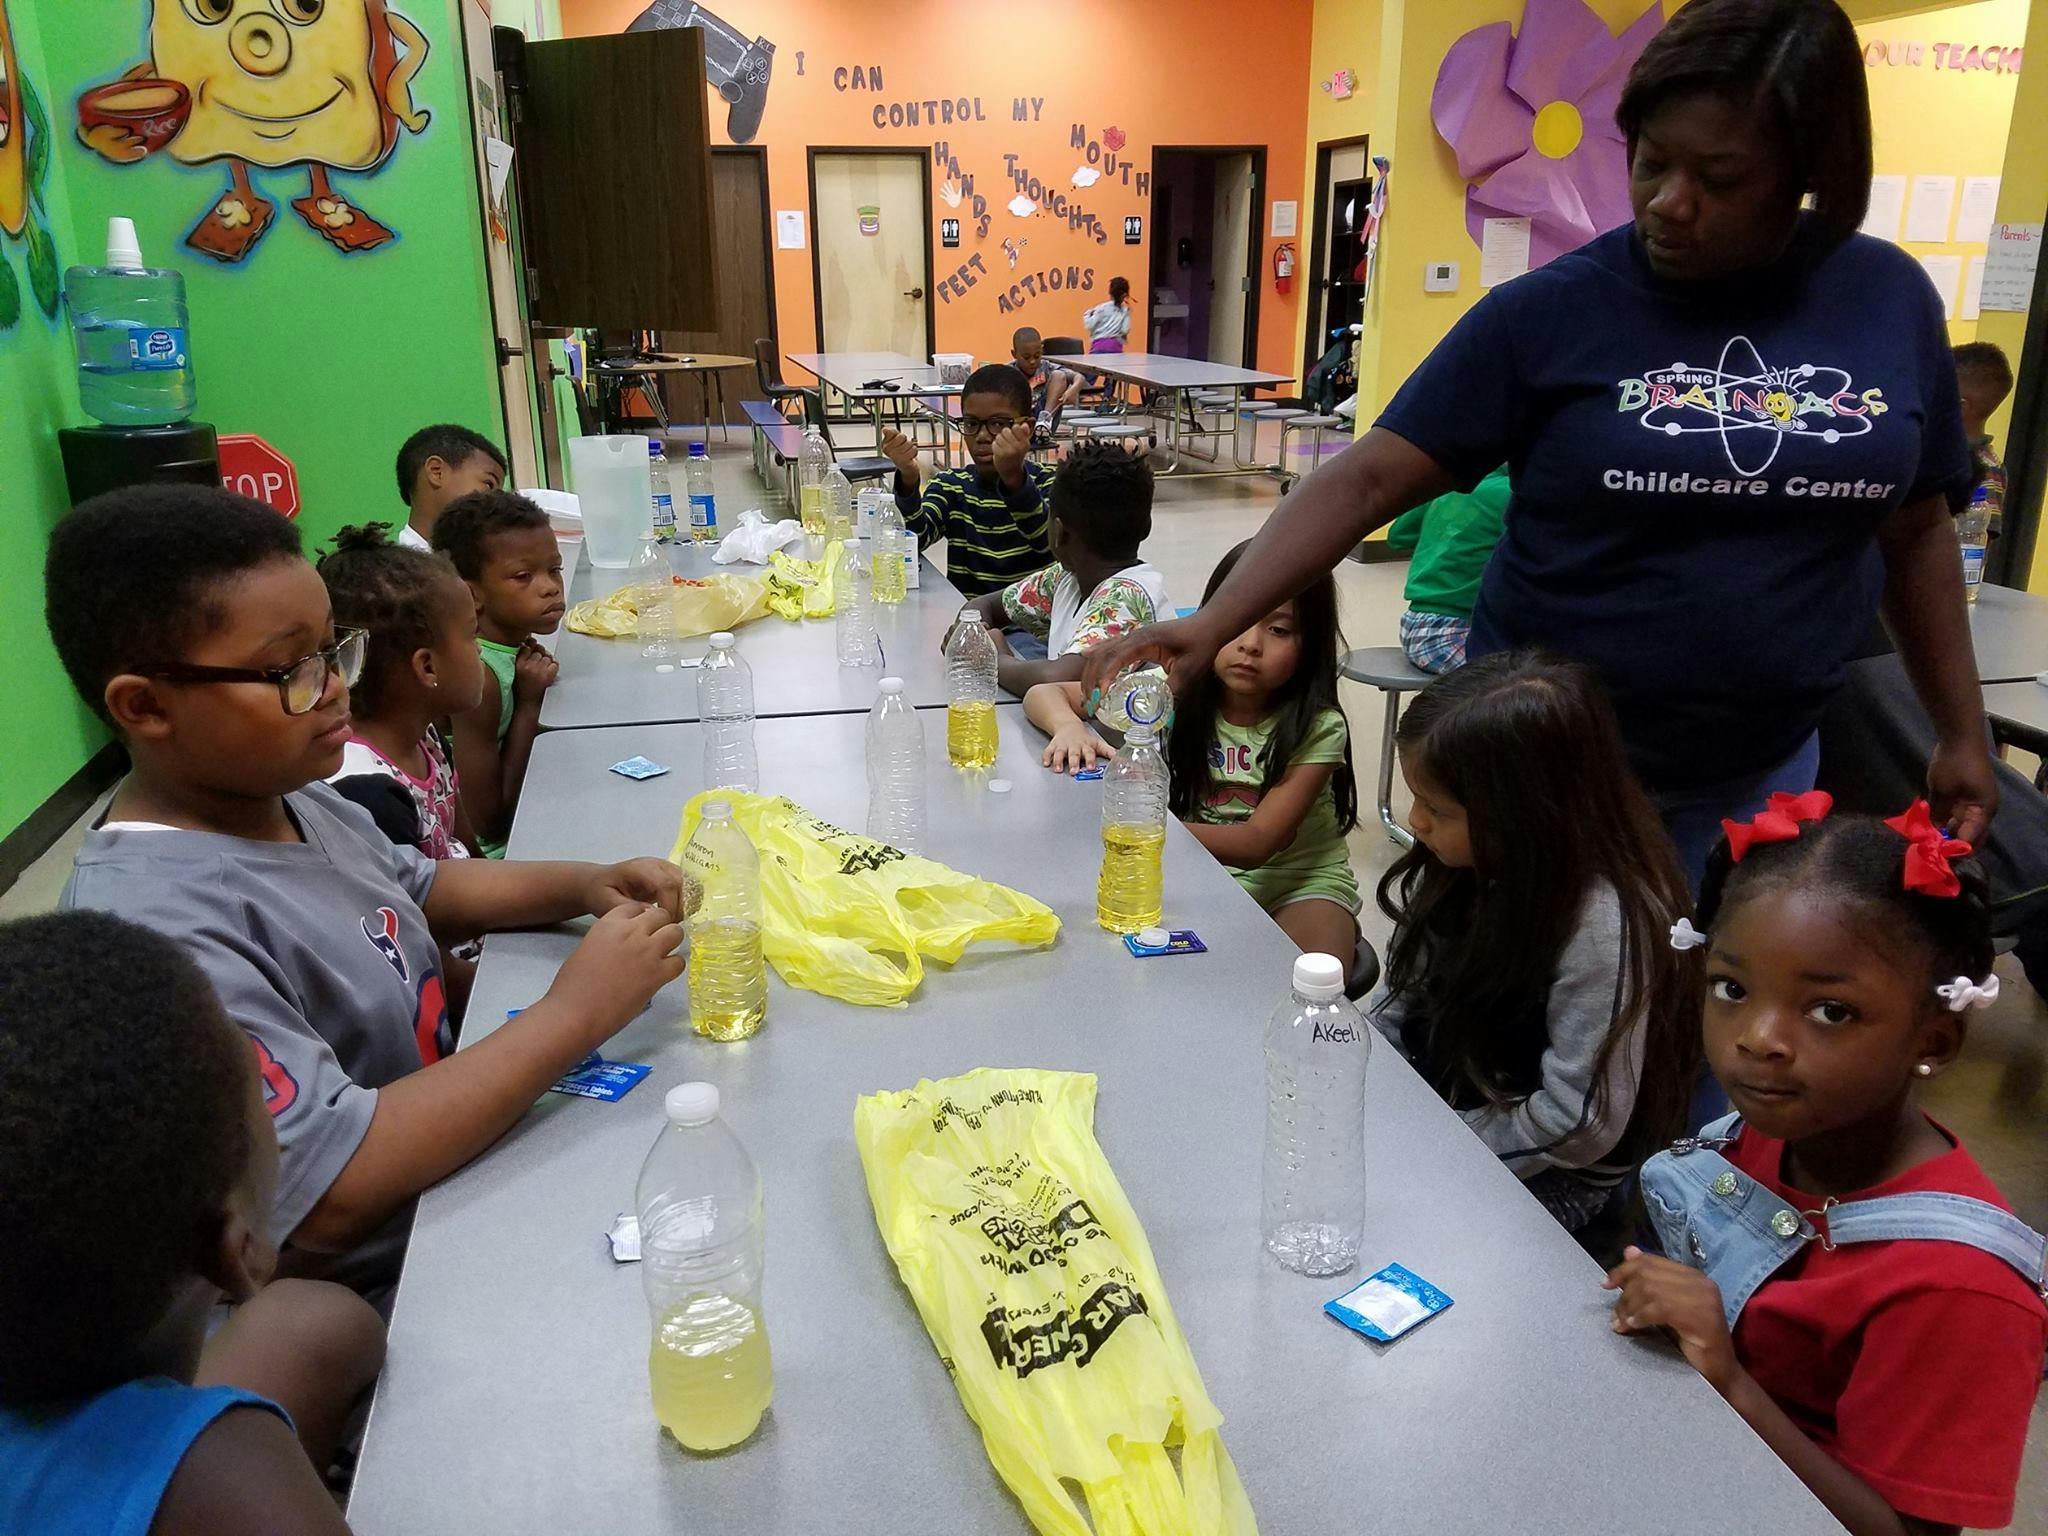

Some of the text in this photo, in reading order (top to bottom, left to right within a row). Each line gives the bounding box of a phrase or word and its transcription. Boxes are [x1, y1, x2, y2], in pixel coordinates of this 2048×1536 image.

[795, 51, 883, 92] I CAN
[1865, 40, 1924, 67] OUR
[873, 97, 1044, 129] CONTROL MY
[1070, 124, 1150, 197] MOUTH
[934, 141, 992, 238] HANDS
[1003, 154, 1107, 245] THOUGHTS
[2000, 224, 2031, 241] Parents
[936, 252, 987, 304] FEET
[998, 266, 1095, 314] ACTIONS
[1617, 378, 1889, 417] BRAINACS
[1656, 373, 1714, 385] SPRING
[222, 472, 283, 504] TOP
[1603, 469, 1896, 499] Childcare Center
